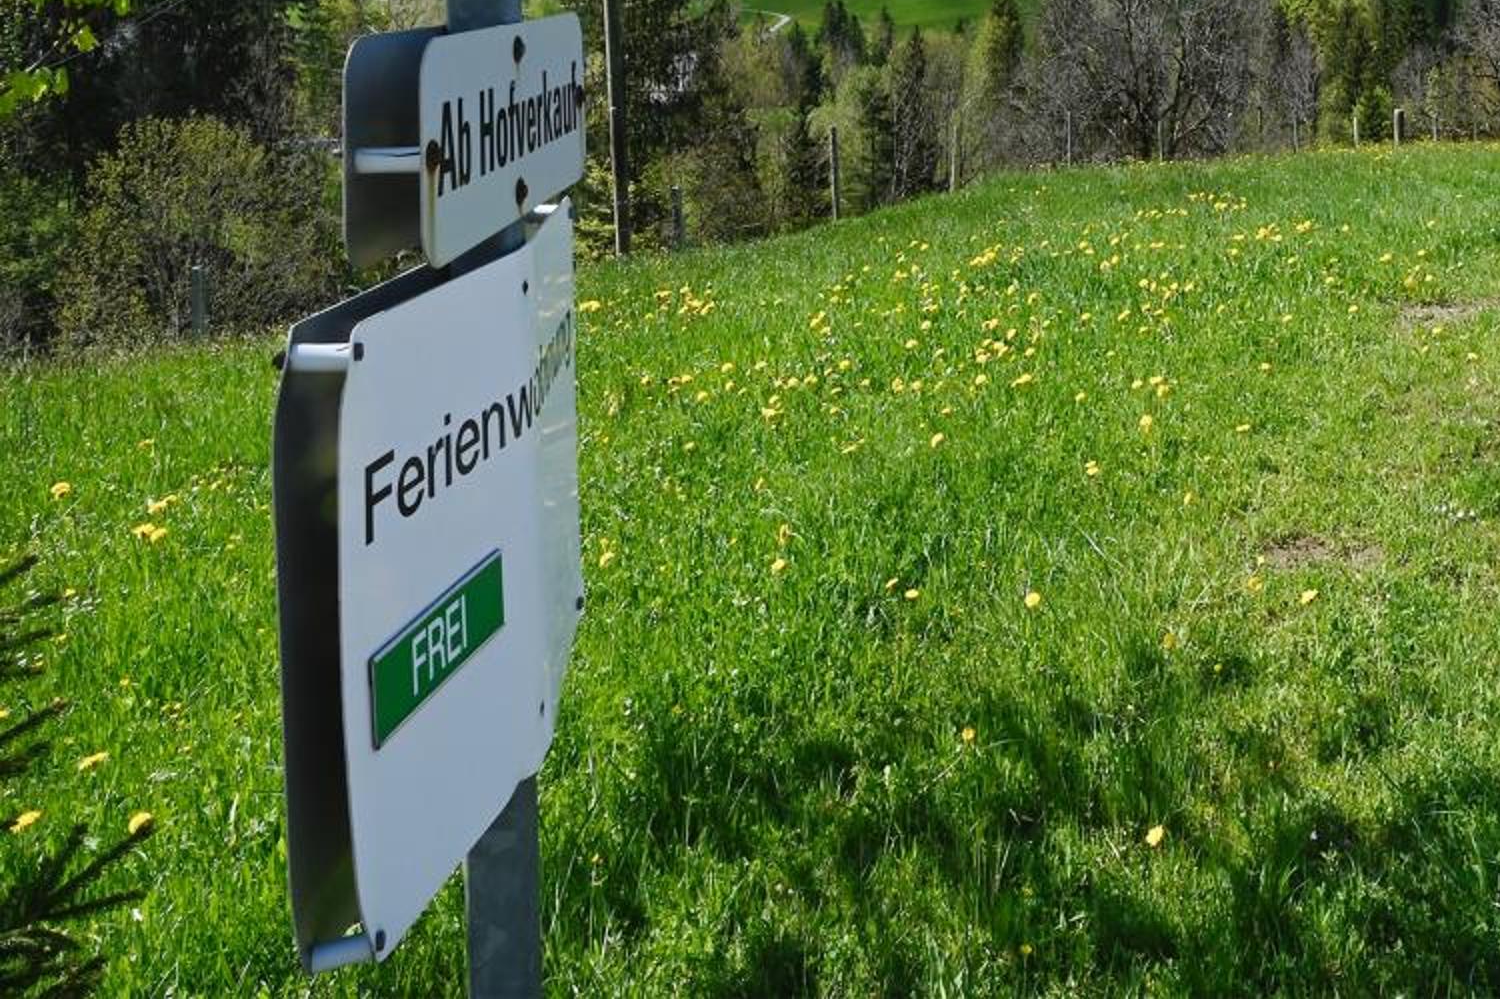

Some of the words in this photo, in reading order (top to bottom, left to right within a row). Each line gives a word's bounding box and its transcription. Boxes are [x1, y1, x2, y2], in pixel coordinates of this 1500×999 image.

[438, 97, 472, 198] Ab
[480, 61, 577, 177] Hofverkauf
[412, 594, 468, 698] FREI
